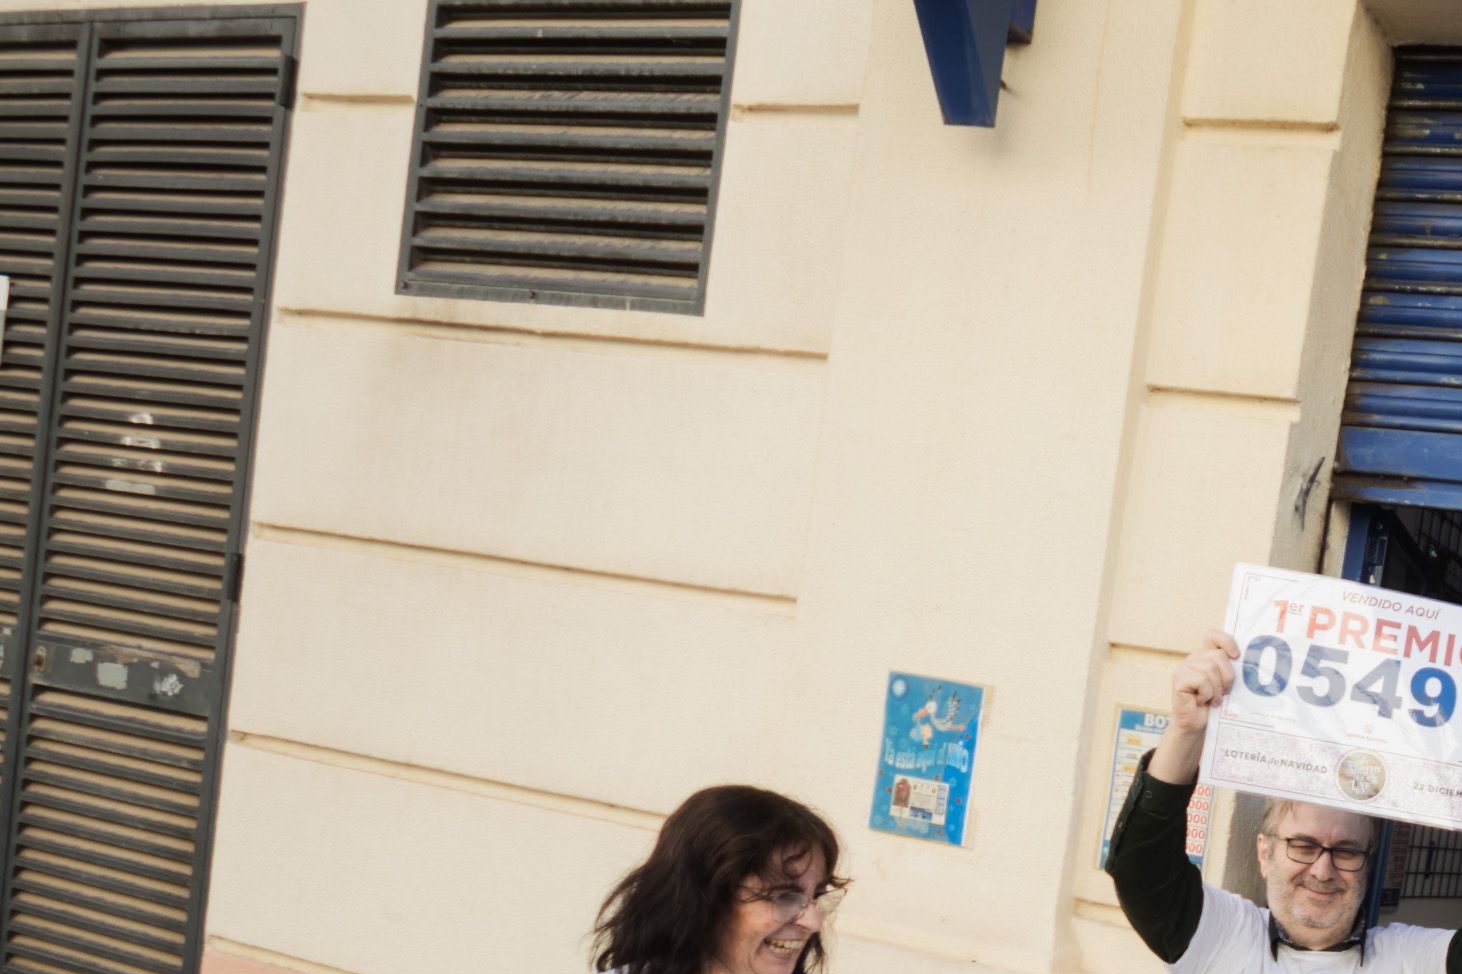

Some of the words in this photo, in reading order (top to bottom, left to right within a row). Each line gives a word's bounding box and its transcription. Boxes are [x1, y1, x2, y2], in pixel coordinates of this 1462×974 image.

[1273, 599, 1305, 633] 1er
[1341, 590, 1402, 614] VENDIDO
[1404, 603, 1441, 620] AQUÍ
[1224, 748, 1268, 766] LOTERÍA
[1280, 757, 1328, 775] NAVIDAD
[1413, 781, 1427, 792] 22
